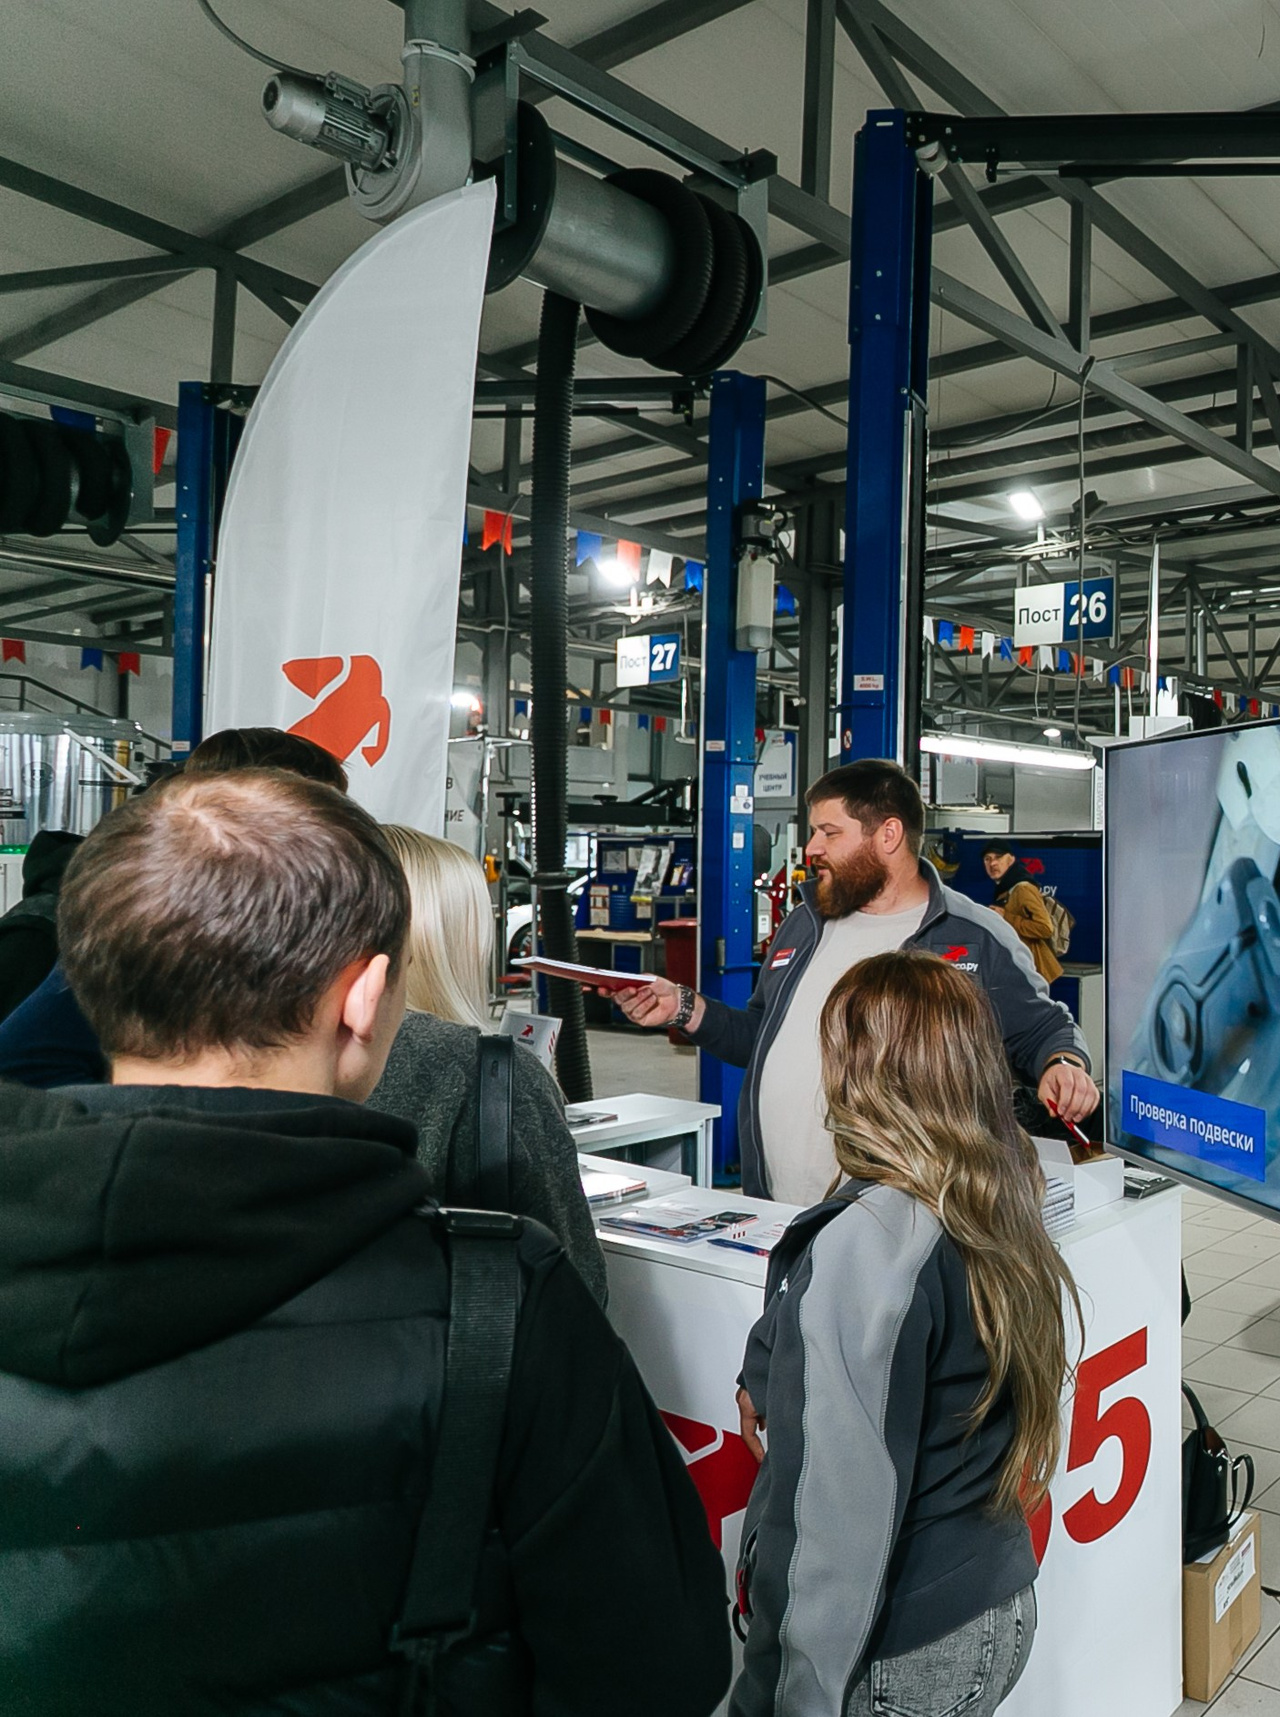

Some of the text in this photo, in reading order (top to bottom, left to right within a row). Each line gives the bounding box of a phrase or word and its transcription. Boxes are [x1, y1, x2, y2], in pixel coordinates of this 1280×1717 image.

[1019, 590, 1107, 626] Пост 26
[620, 642, 677, 672] Пост 27
[763, 784, 782, 792] ЦЕНТР
[1130, 1094, 1254, 1154] Проверка подвески
[1024, 1325, 1152, 1562] 5
